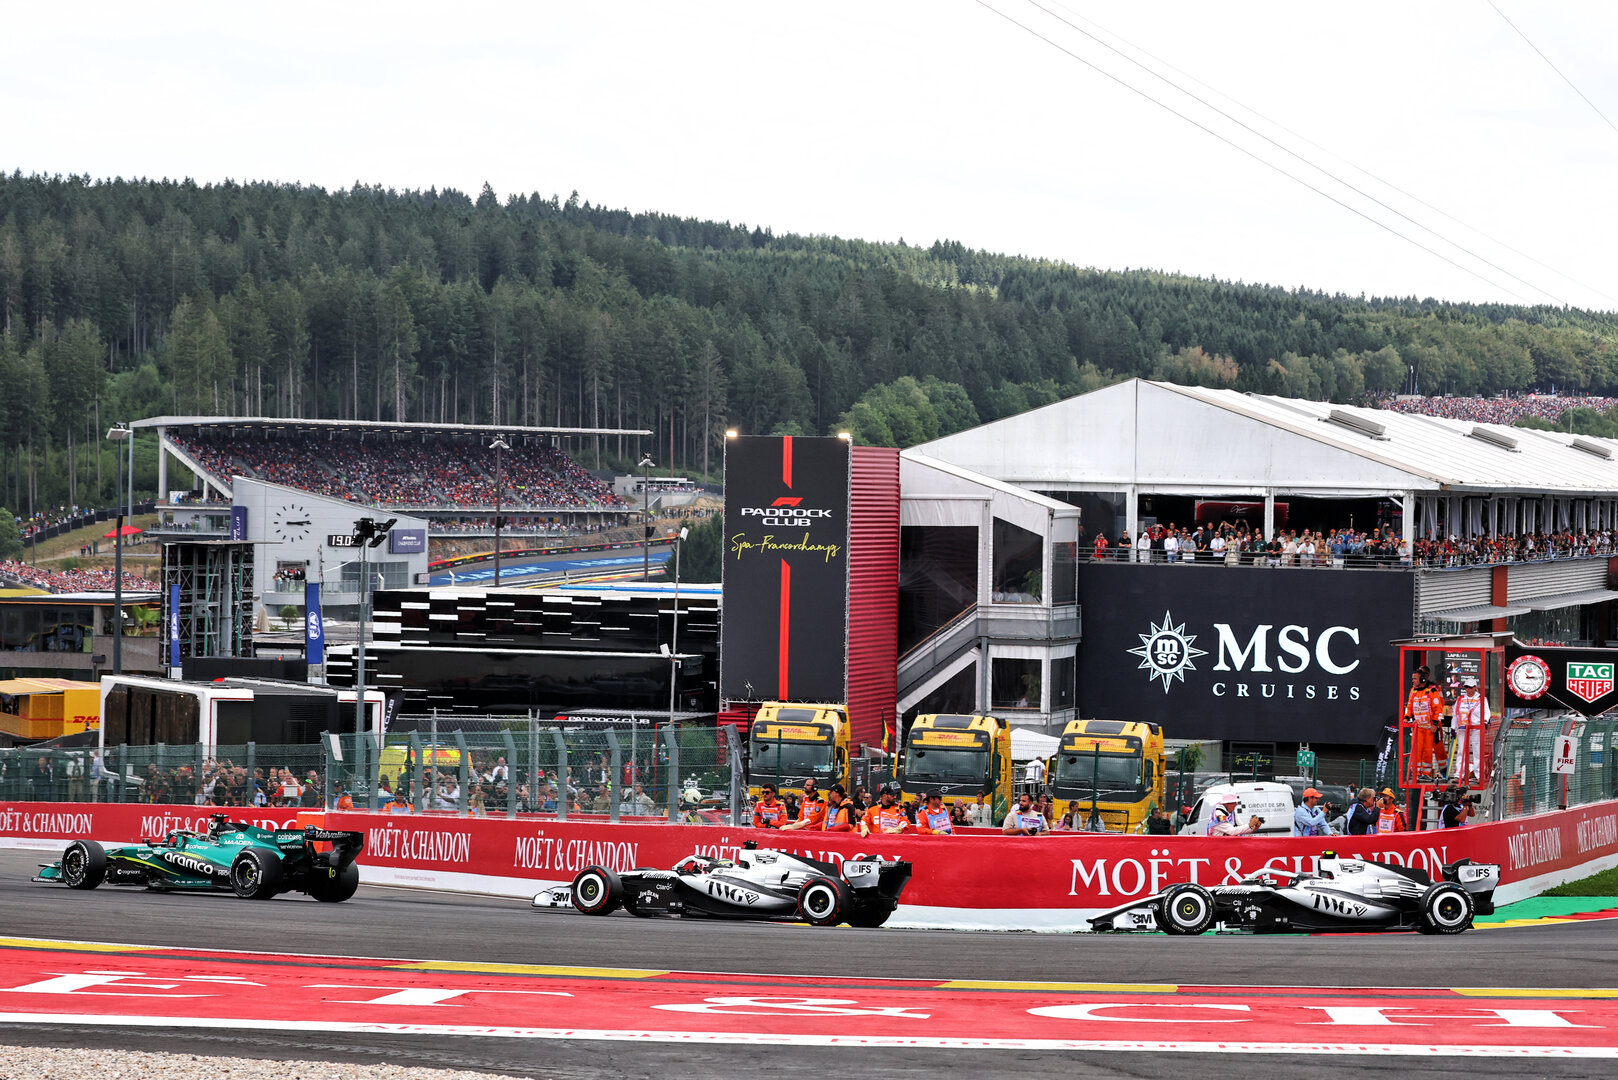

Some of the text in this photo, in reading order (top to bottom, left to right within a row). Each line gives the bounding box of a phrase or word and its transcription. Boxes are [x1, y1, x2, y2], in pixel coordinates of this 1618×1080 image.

[741, 507, 832, 518] PADDOCK
[762, 517, 812, 527] CLUB
[731, 532, 841, 563] Spa-Francorchamps
[309, 613, 321, 640] FIA
[1213, 623, 1360, 675] MSC
[1571, 665, 1610, 678] TAG
[1212, 683, 1360, 700] CRUISES
[1569, 680, 1611, 700] HEUER
[568, 716, 621, 724] PADDOCK
[23, 812, 31, 832] &
[33, 813, 93, 834] CHANDON
[184, 816, 193, 832] &
[367, 822, 472, 863] MOËT & CHANDON
[514, 830, 638, 873] MOËT & CHANDON
[1534, 827, 1562, 864] CHANDON
[164, 852, 214, 875] aramco
[859, 864, 872, 873] IFS
[1068, 849, 1210, 897] MOËT
[1475, 868, 1490, 877] IFS
[552, 892, 570, 902] 3M
[705, 879, 744, 902] TWG
[1310, 892, 1352, 915] TWG
[1132, 914, 1152, 924] 3M
